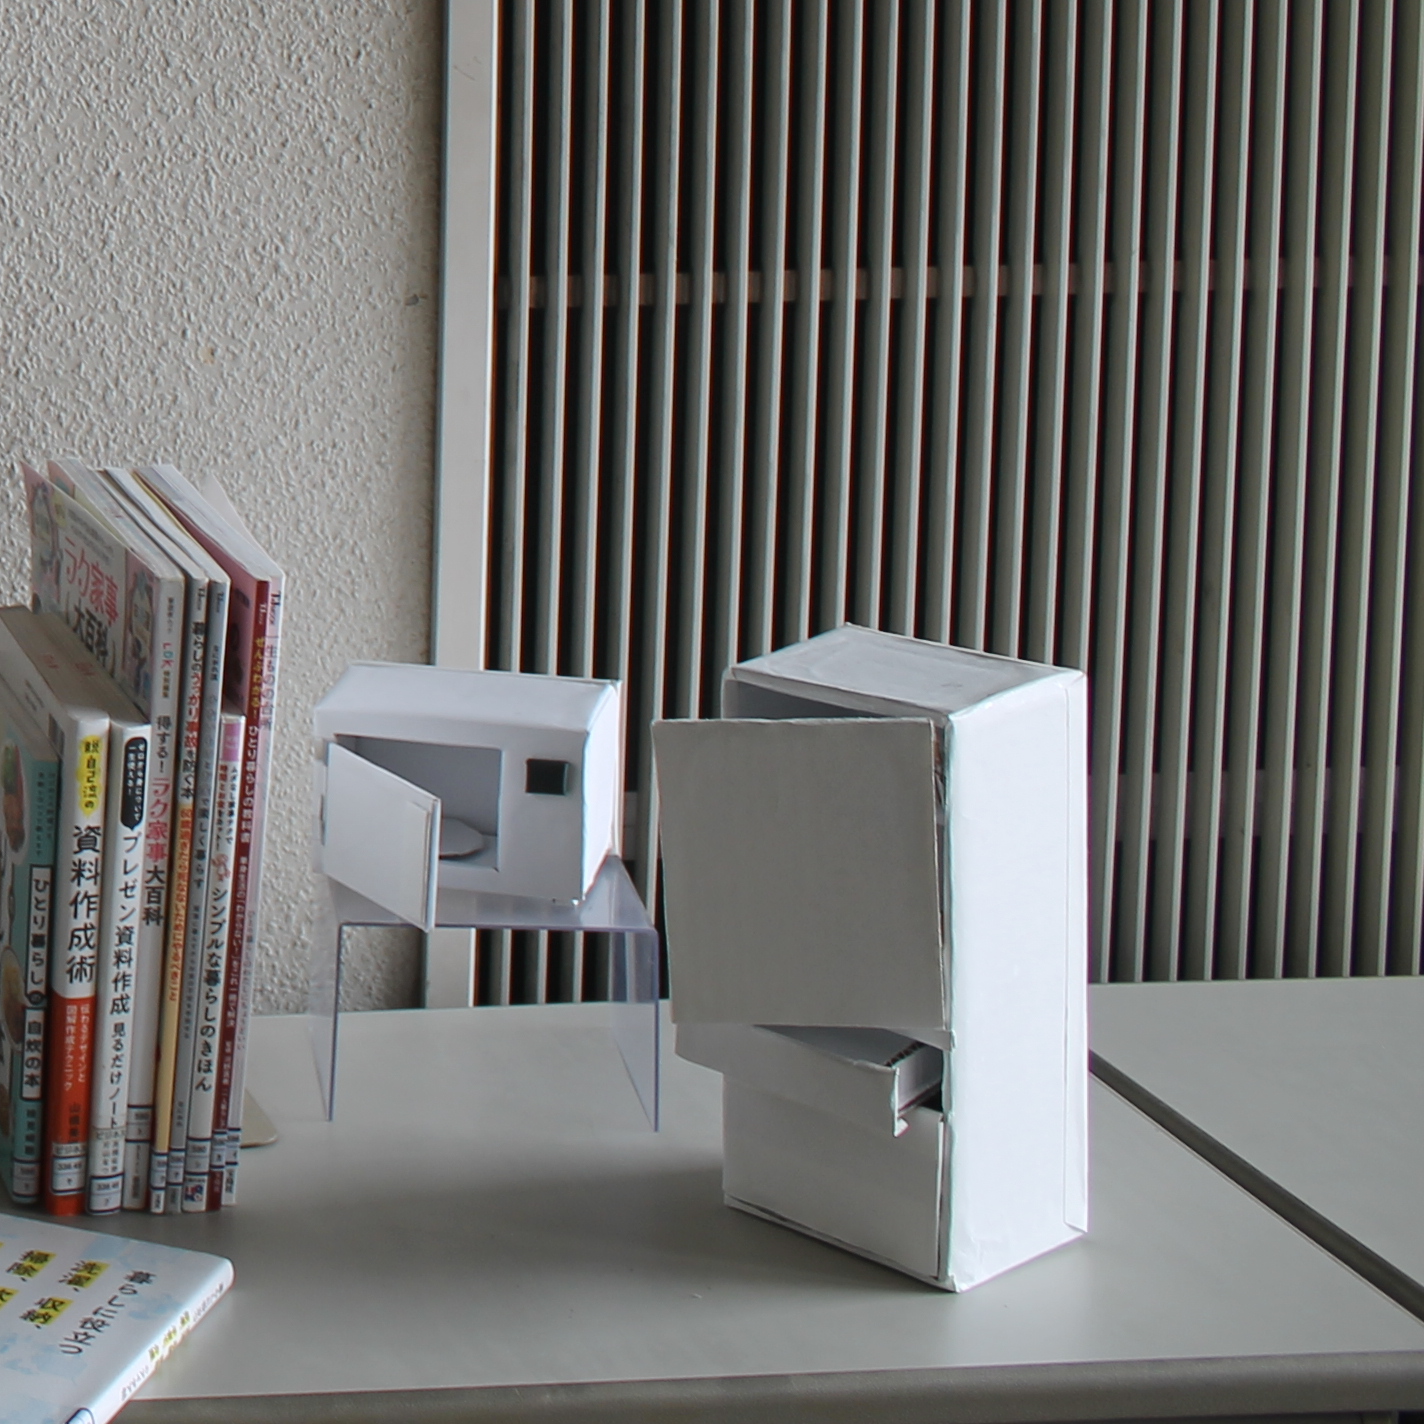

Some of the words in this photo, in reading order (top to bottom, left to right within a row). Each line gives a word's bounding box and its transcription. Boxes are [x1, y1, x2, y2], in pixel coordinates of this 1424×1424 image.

[66, 825, 101, 984] 資料作成術
[108, 830, 143, 1014] プレゼン資料作成
[194, 886, 230, 1093] シンプルな暮らしのきほん
[60, 1269, 156, 1354] 暮らしに役立つ
